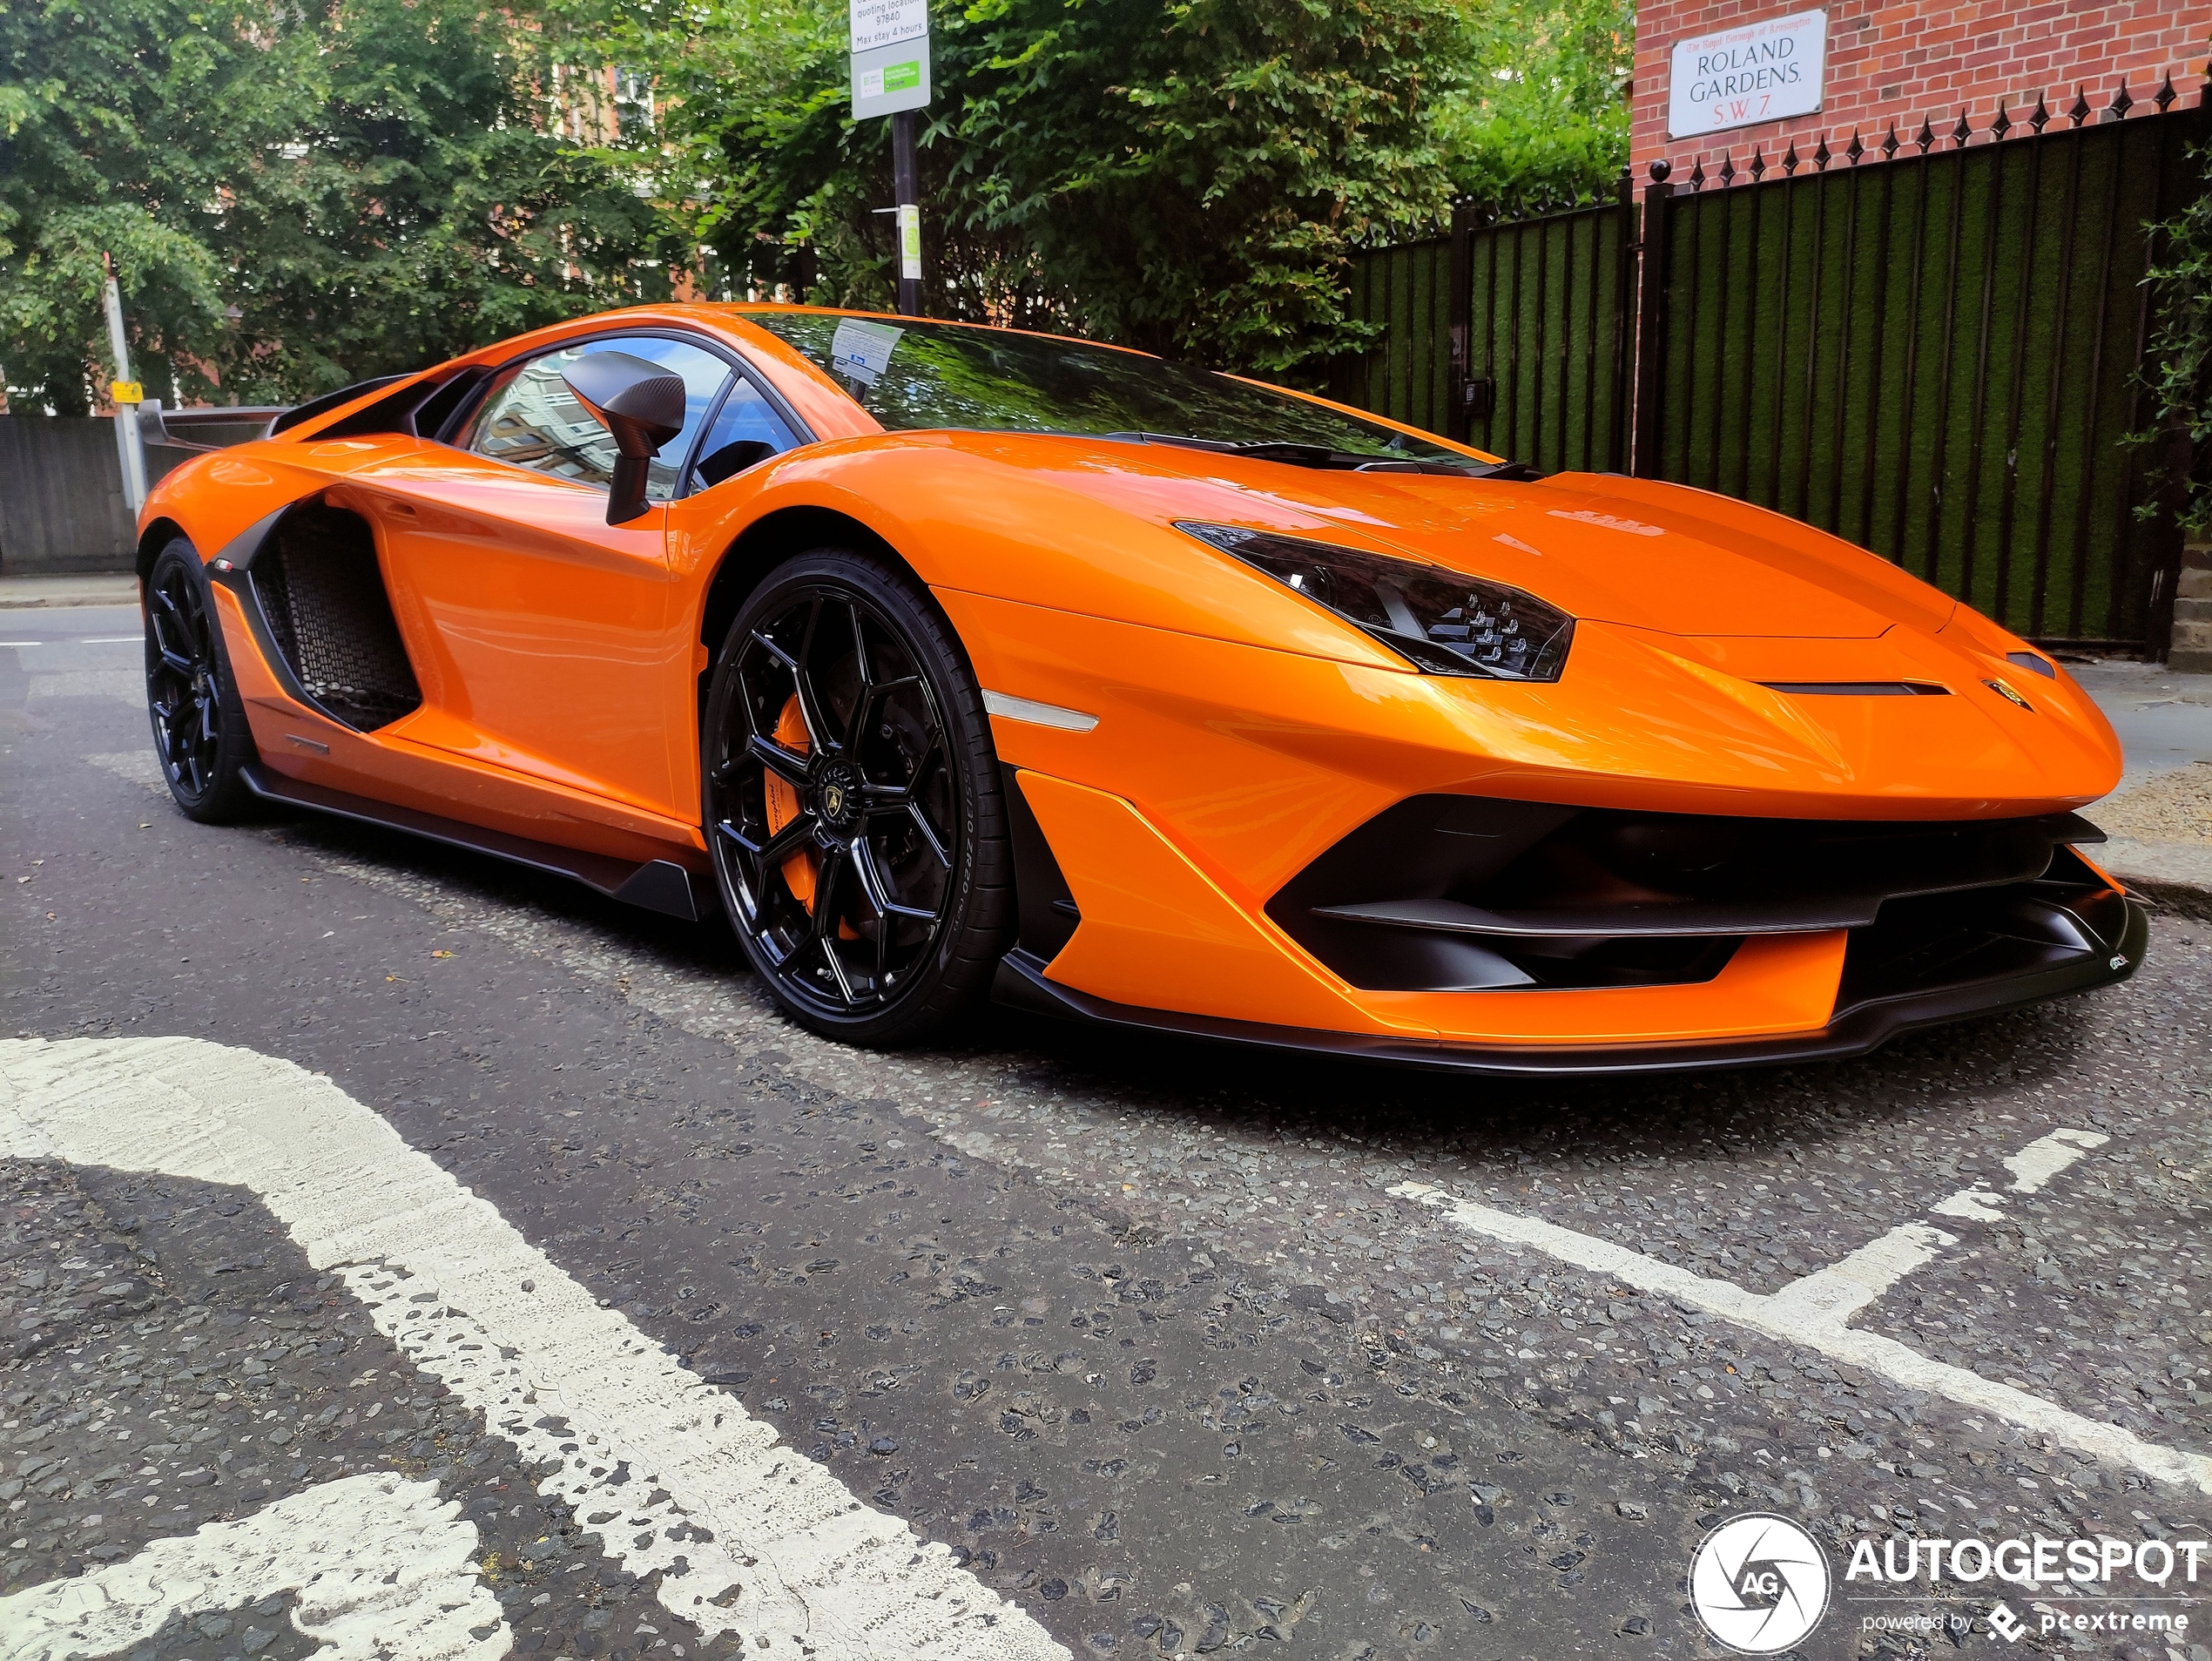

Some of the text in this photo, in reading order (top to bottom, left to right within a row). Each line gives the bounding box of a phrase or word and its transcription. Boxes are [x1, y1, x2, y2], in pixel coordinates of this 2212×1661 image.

[858, 4, 886, 18] quoting
[875, 11, 900, 26] 97840
[857, 24, 922, 46] Max stay 4 hours
[1703, 38, 1722, 50] Royal
[1725, 31, 1754, 44] Borough
[1758, 26, 1766, 37] of
[1769, 17, 1811, 34] Kensington
[1698, 37, 1794, 77] ROLAND
[1690, 62, 1802, 103] GARDENS.
[1714, 98, 1750, 125] S.W.
[961, 758, 974, 834] 255/30
[961, 838, 974, 895] ZR20
